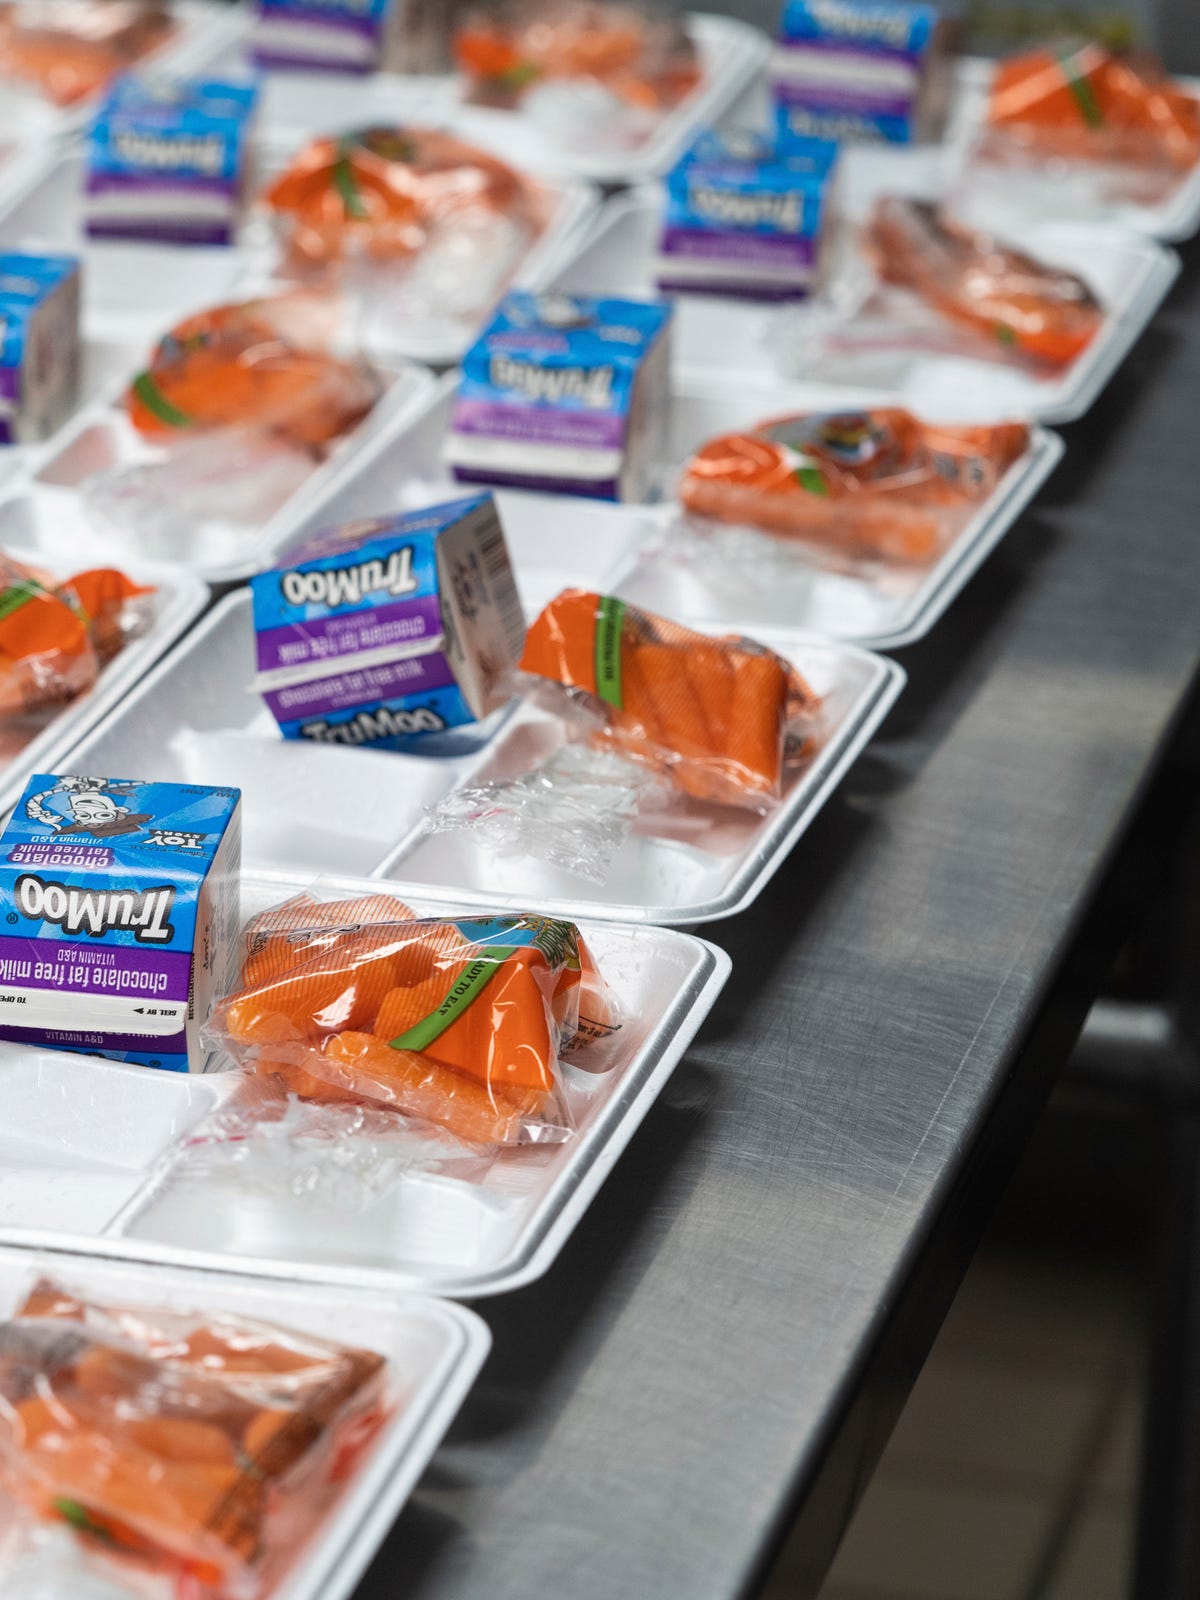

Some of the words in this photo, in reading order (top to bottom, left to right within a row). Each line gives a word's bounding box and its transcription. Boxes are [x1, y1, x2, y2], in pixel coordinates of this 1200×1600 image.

[283, 547, 417, 606] TruMoo
[59, 836, 104, 845] vitamin
[141, 834, 203, 849] TOY
[153, 829, 201, 840] STORY
[18, 844, 49, 854] milk
[53, 846, 84, 856] free
[85, 846, 110, 857] fat
[11, 851, 110, 868] chocolate
[20, 877, 172, 939] TruMoo
[57, 948, 77, 962] A&D
[78, 949, 115, 965] VITAMIN
[0, 958, 31, 981] milk
[34, 962, 66, 985] free
[69, 965, 90, 986] fat
[92, 967, 168, 993] chocolate
[455, 979, 471, 997] TO
[17, 996, 27, 1004] TO
[438, 994, 458, 1016] EAT
[44, 1031, 83, 1043] VITAMIN
[84, 1033, 104, 1045] A&D
